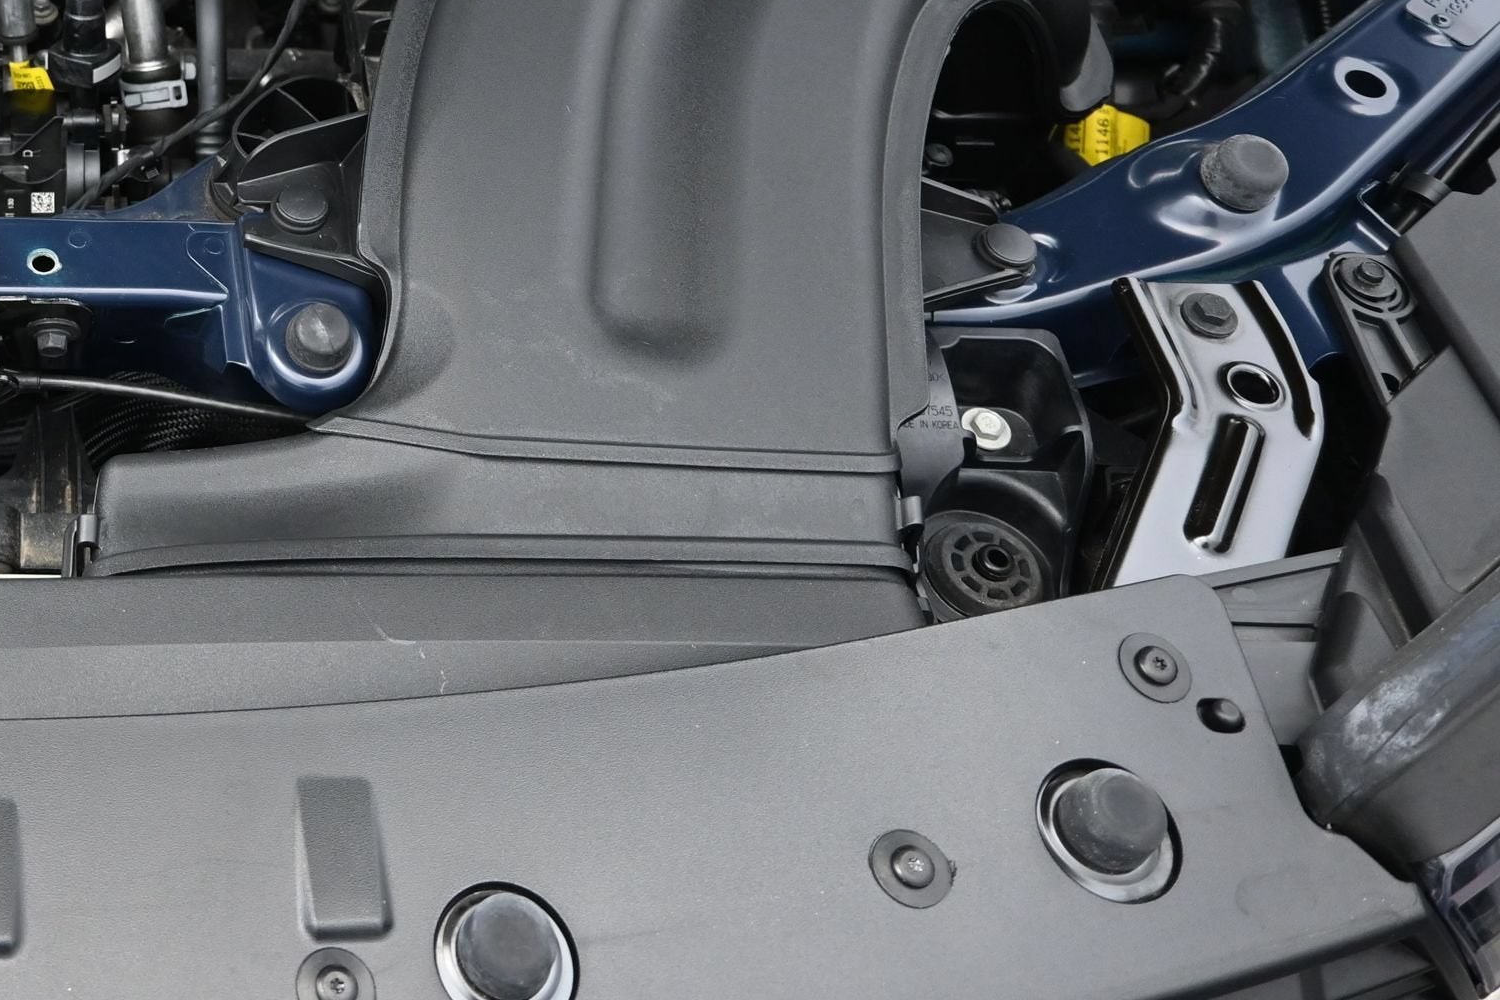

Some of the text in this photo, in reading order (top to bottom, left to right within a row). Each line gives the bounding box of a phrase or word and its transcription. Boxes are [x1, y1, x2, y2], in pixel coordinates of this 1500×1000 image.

[1095, 118, 1110, 156] 1146
[920, 420, 929, 429] IN
[931, 420, 959, 430] KOREA
